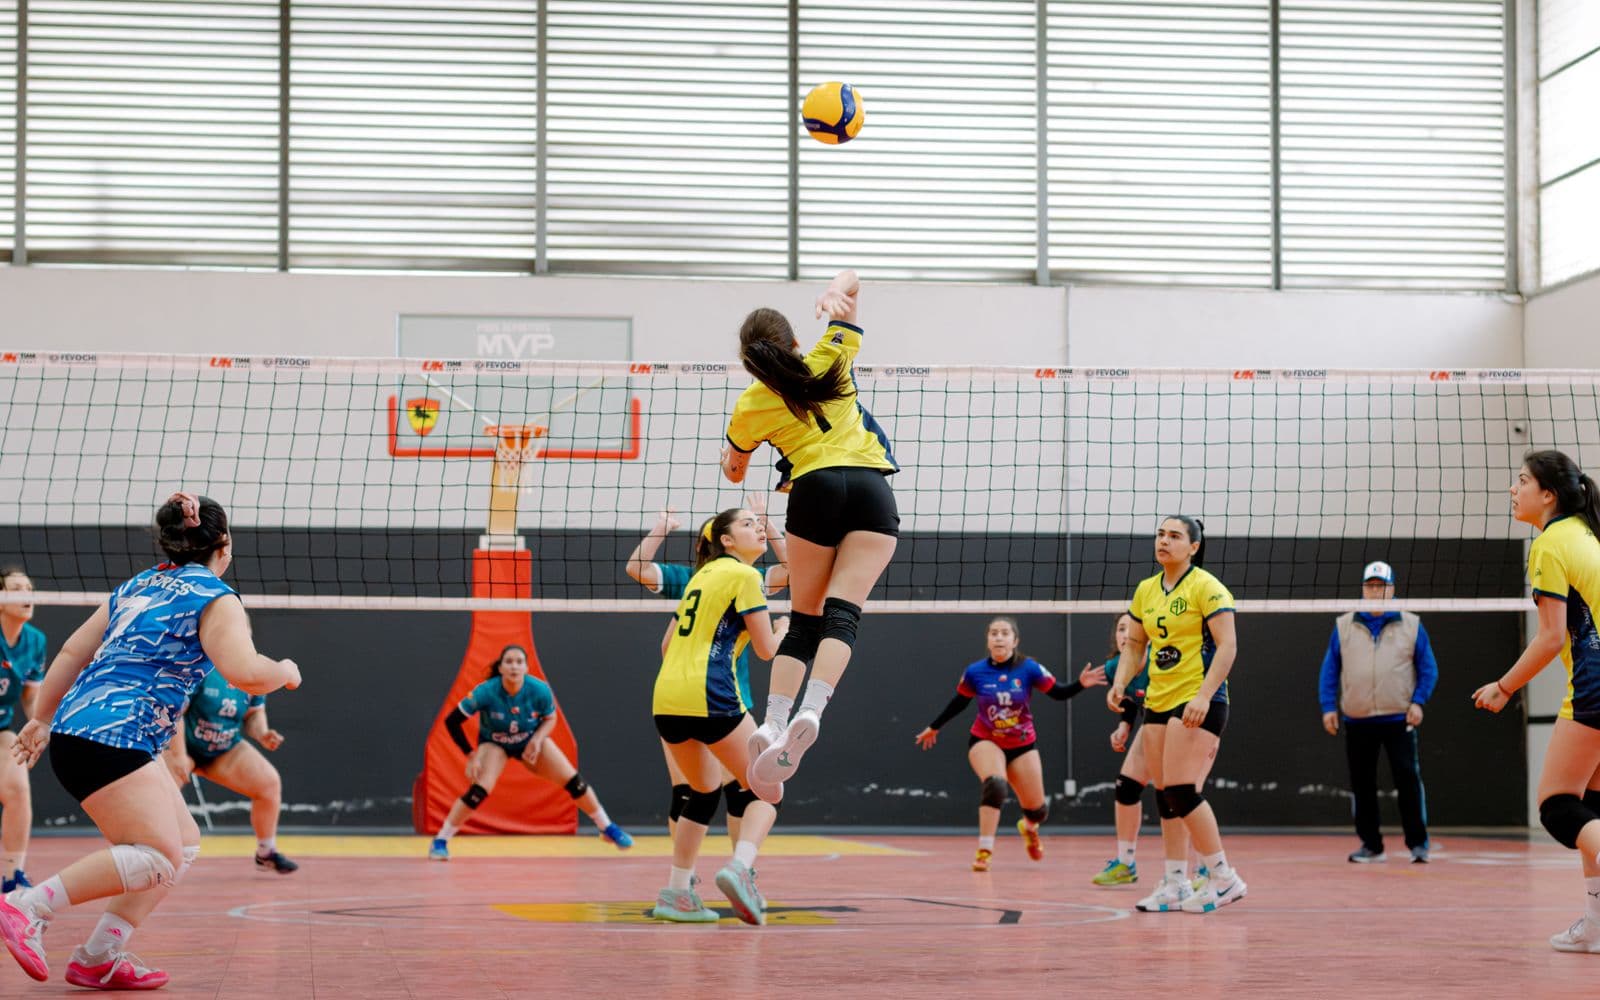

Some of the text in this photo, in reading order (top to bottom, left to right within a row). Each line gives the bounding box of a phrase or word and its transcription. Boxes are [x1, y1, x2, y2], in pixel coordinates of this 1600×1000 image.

[478, 333, 555, 358] MVP
[60, 353, 97, 361] FEVOCHI
[275, 357, 310, 366] FEVOCHI
[485, 361, 520, 369] FEVOCHI
[692, 364, 727, 372] FEVOCHI
[896, 367, 930, 375] FEVOCHI
[1095, 368, 1130, 377] FEVOCHI
[1293, 369, 1327, 377] FEVOCHI
[1488, 370, 1521, 378] FEVOCHI
[678, 589, 702, 637] 3
[1157, 616, 1168, 639] 5
[996, 691, 1012, 706] 12
[219, 698, 237, 717] 26
